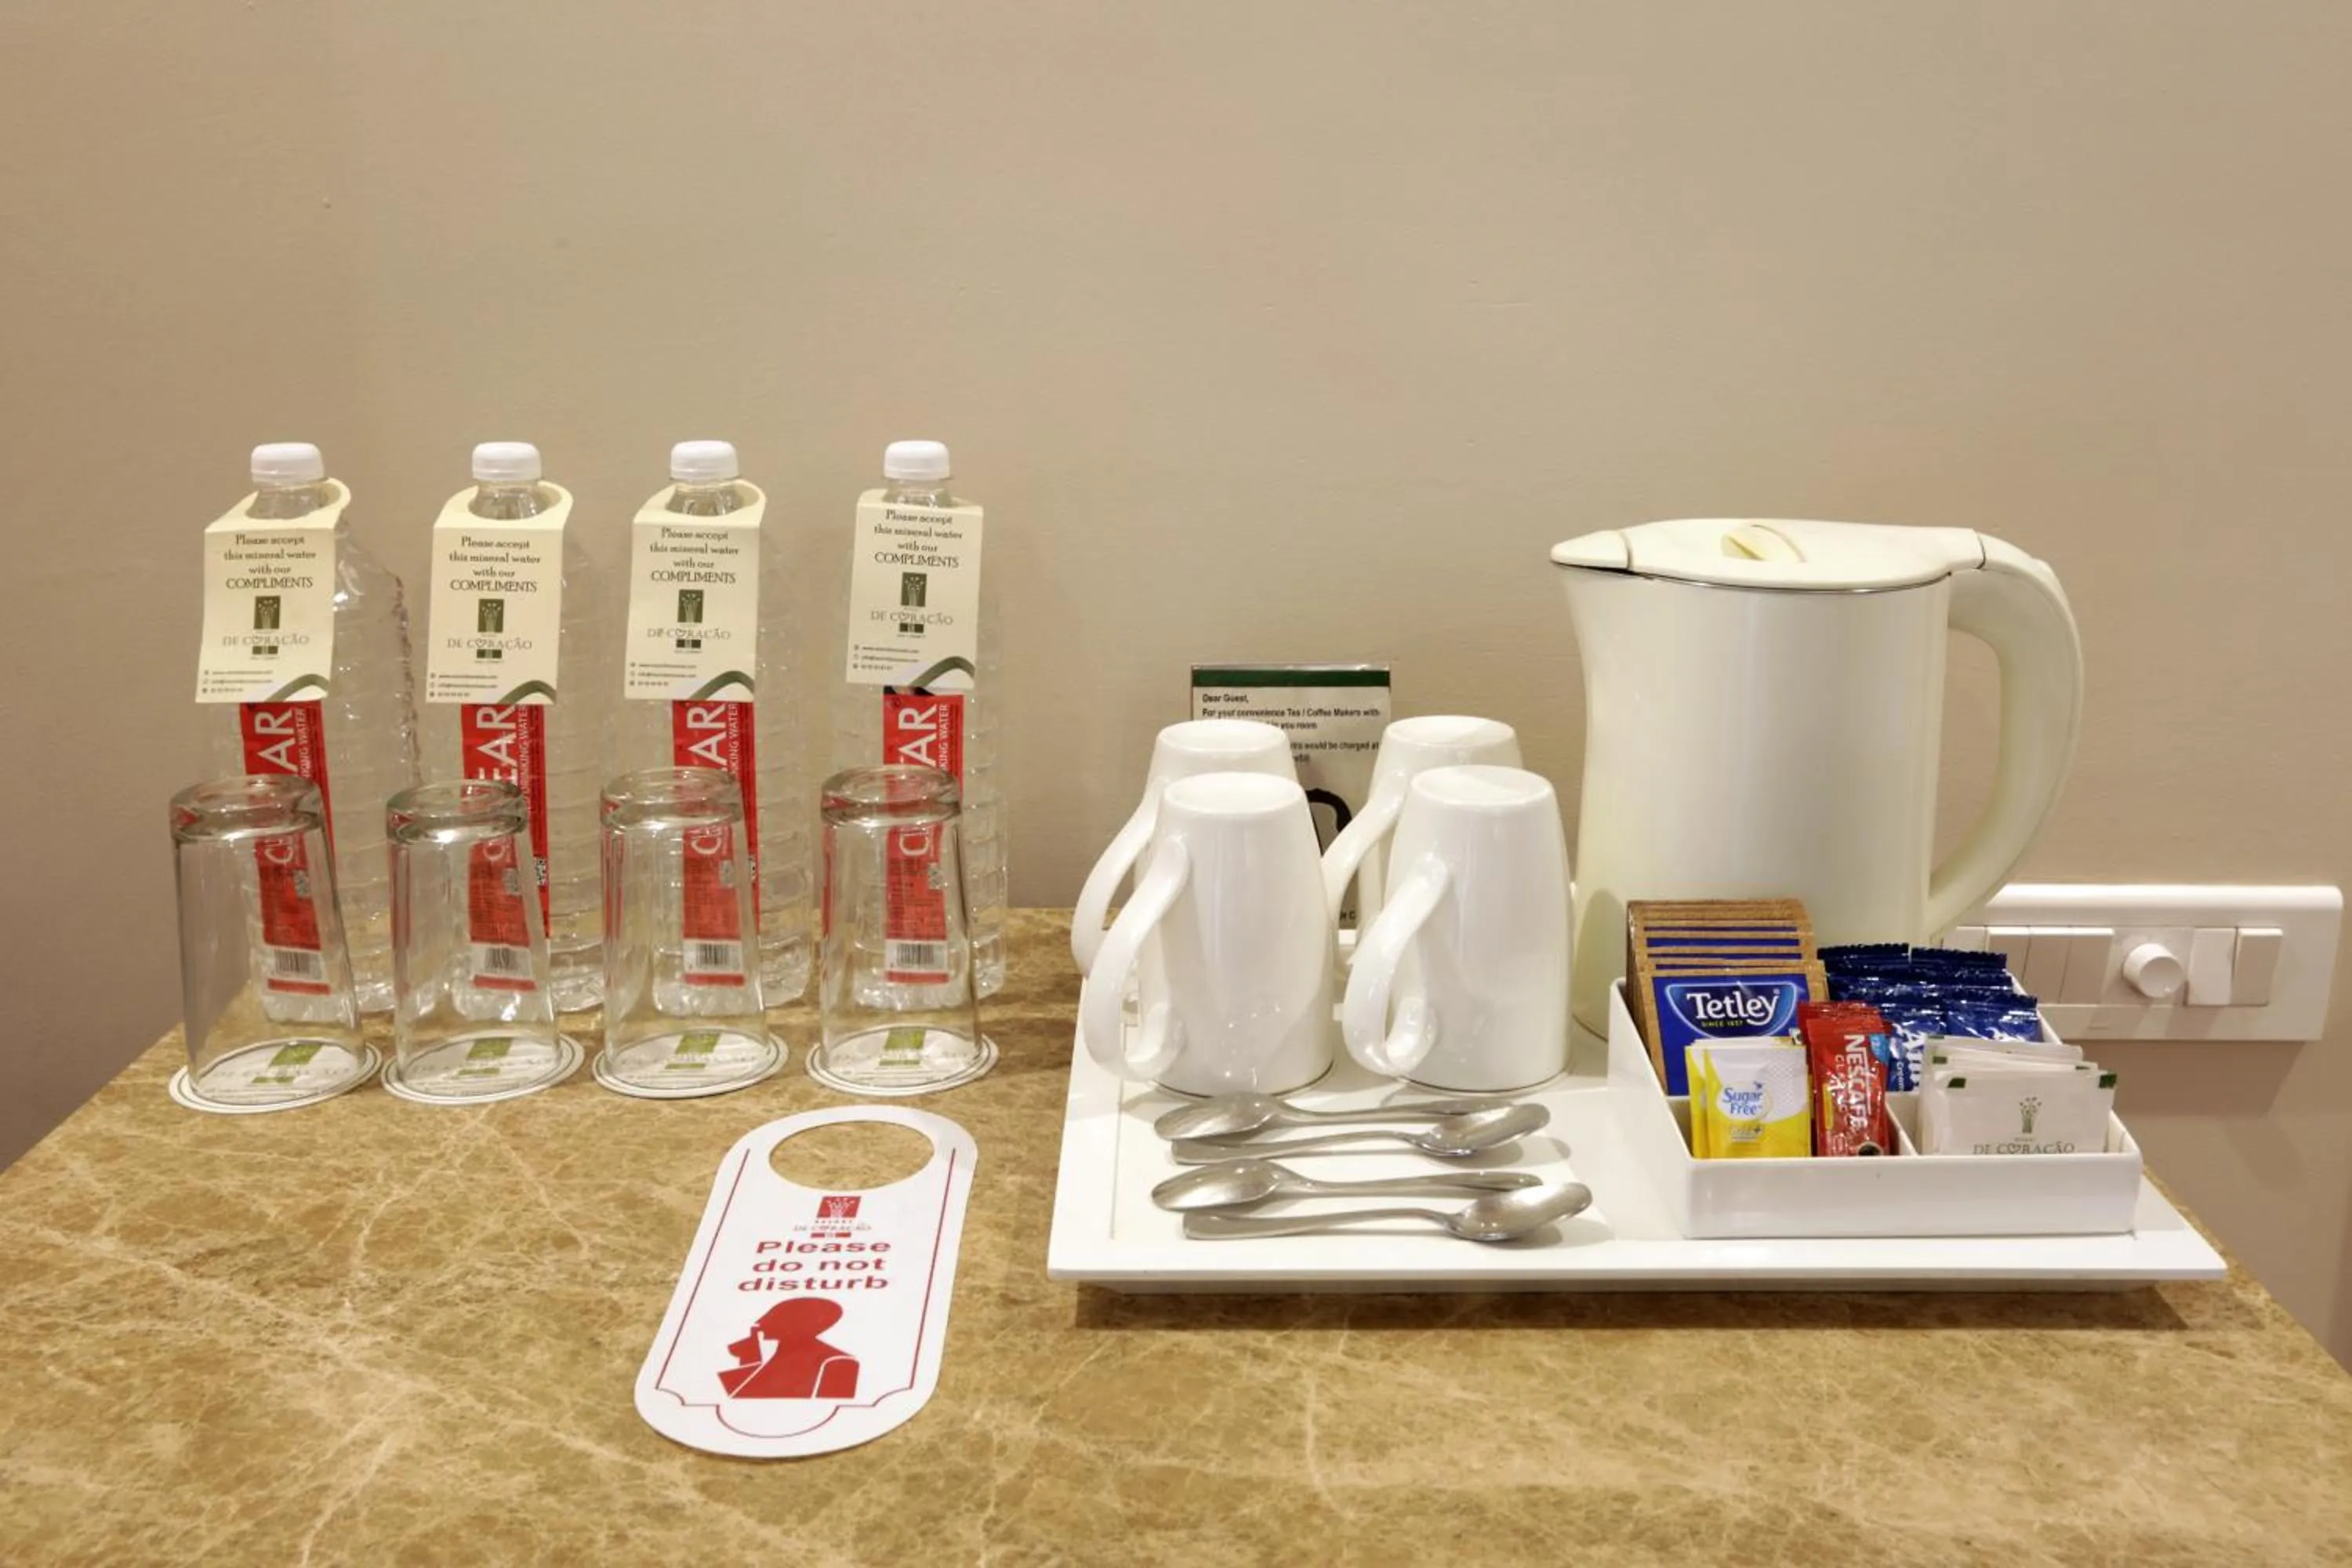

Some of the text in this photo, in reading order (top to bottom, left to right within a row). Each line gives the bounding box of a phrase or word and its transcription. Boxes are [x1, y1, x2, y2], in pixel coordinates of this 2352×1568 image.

[885, 510, 953, 525] Please accept
[661, 527, 729, 542] Please accept
[874, 524, 963, 539] this mineral water
[235, 534, 305, 546] Please accept
[461, 535, 530, 550] Please accept
[898, 541, 920, 551] with
[224, 549, 317, 561] this mineral water
[650, 543, 739, 555] this mineral water
[449, 552, 541, 564] this mineral water
[673, 557, 715, 569] with our
[874, 551, 960, 568] COMPLIMENTS
[249, 565, 272, 574] with
[472, 567, 497, 577] with
[226, 577, 313, 589] COMPLIMENTS
[651, 570, 737, 585] COMPLIMENTS
[450, 579, 538, 593] COMPLIMENTS
[1202, 694, 1221, 702] Dear
[728, 703, 739, 738] WATER
[1202, 708, 1215, 717] For
[1218, 710, 1235, 719] your
[1306, 708, 1331, 717] Coffee
[1334, 708, 1361, 717] Makers
[295, 708, 309, 746] WATER
[938, 703, 948, 739] WATER
[1305, 740, 1327, 750] would
[1327, 740, 1338, 750] be
[1339, 740, 1370, 751] charged
[1686, 990, 1779, 1026] Tetley
[1722, 1087, 1763, 1106] Sugar
[1730, 1102, 1757, 1116] Free
[1973, 1144, 1992, 1154] DE
[757, 1241, 891, 1254] Please
[753, 1258, 887, 1272] do not
[738, 1276, 889, 1291] disturb
